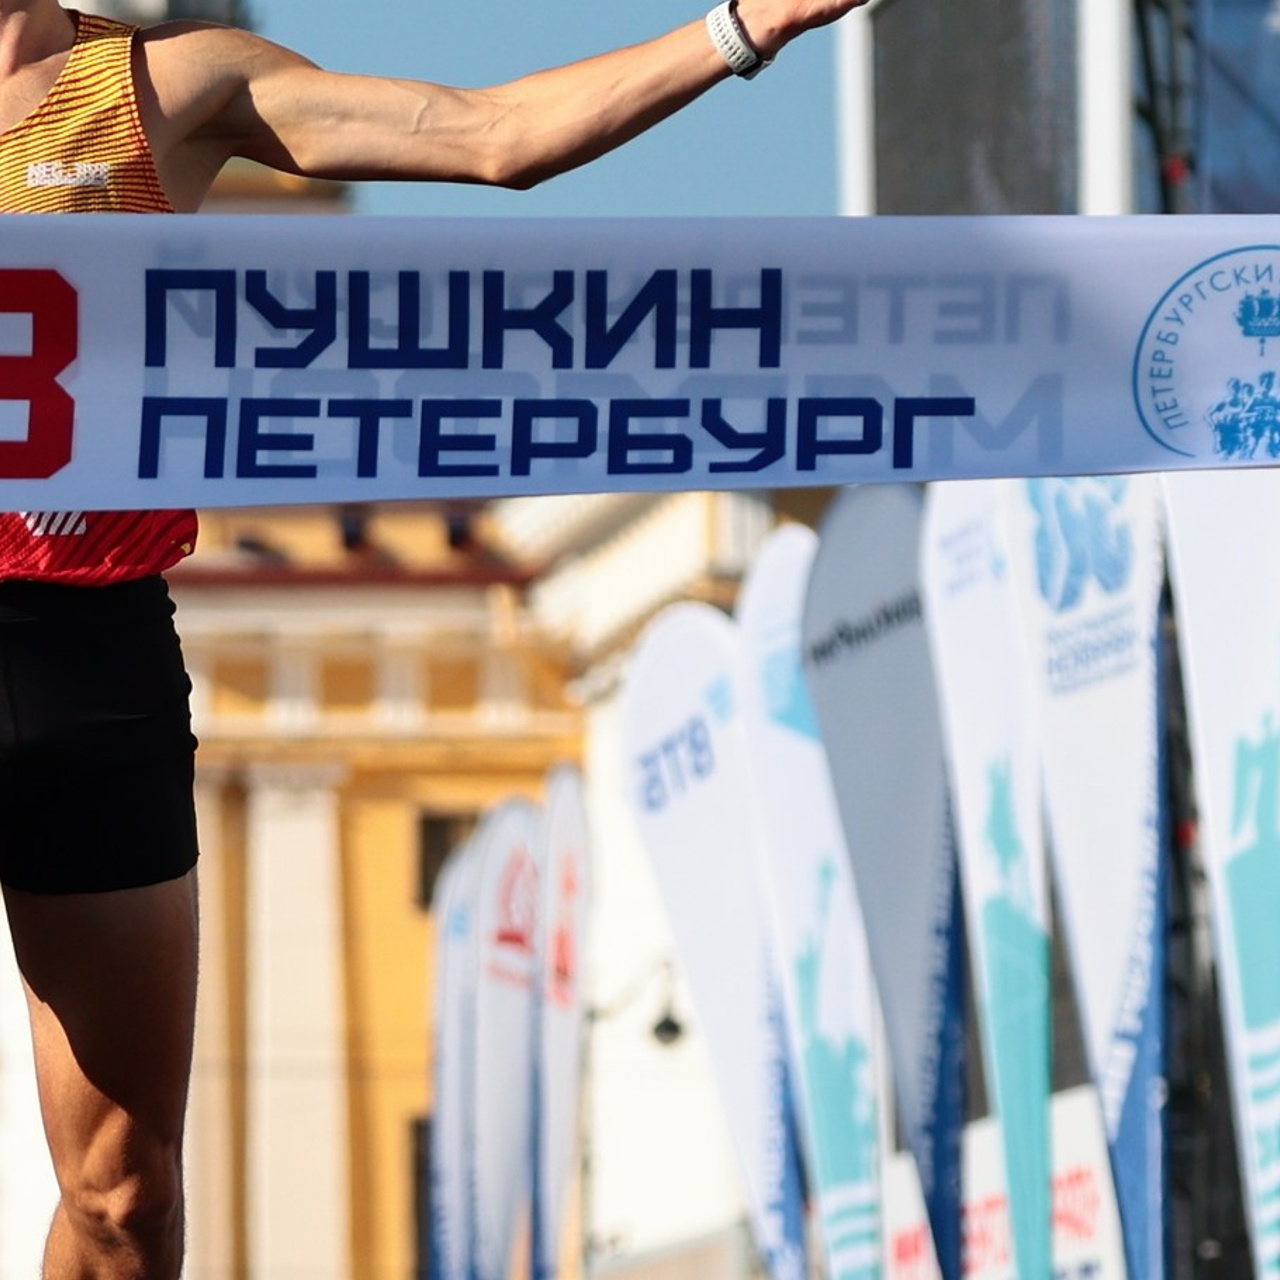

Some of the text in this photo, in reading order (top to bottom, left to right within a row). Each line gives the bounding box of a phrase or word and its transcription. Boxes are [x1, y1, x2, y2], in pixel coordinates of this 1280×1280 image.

[143, 268, 782, 369] ПУШКИН
[1149, 263, 1280, 429] ПЕТЕРБУРГСКИ
[137, 396, 976, 479] ПЕТЕРБУРГ
